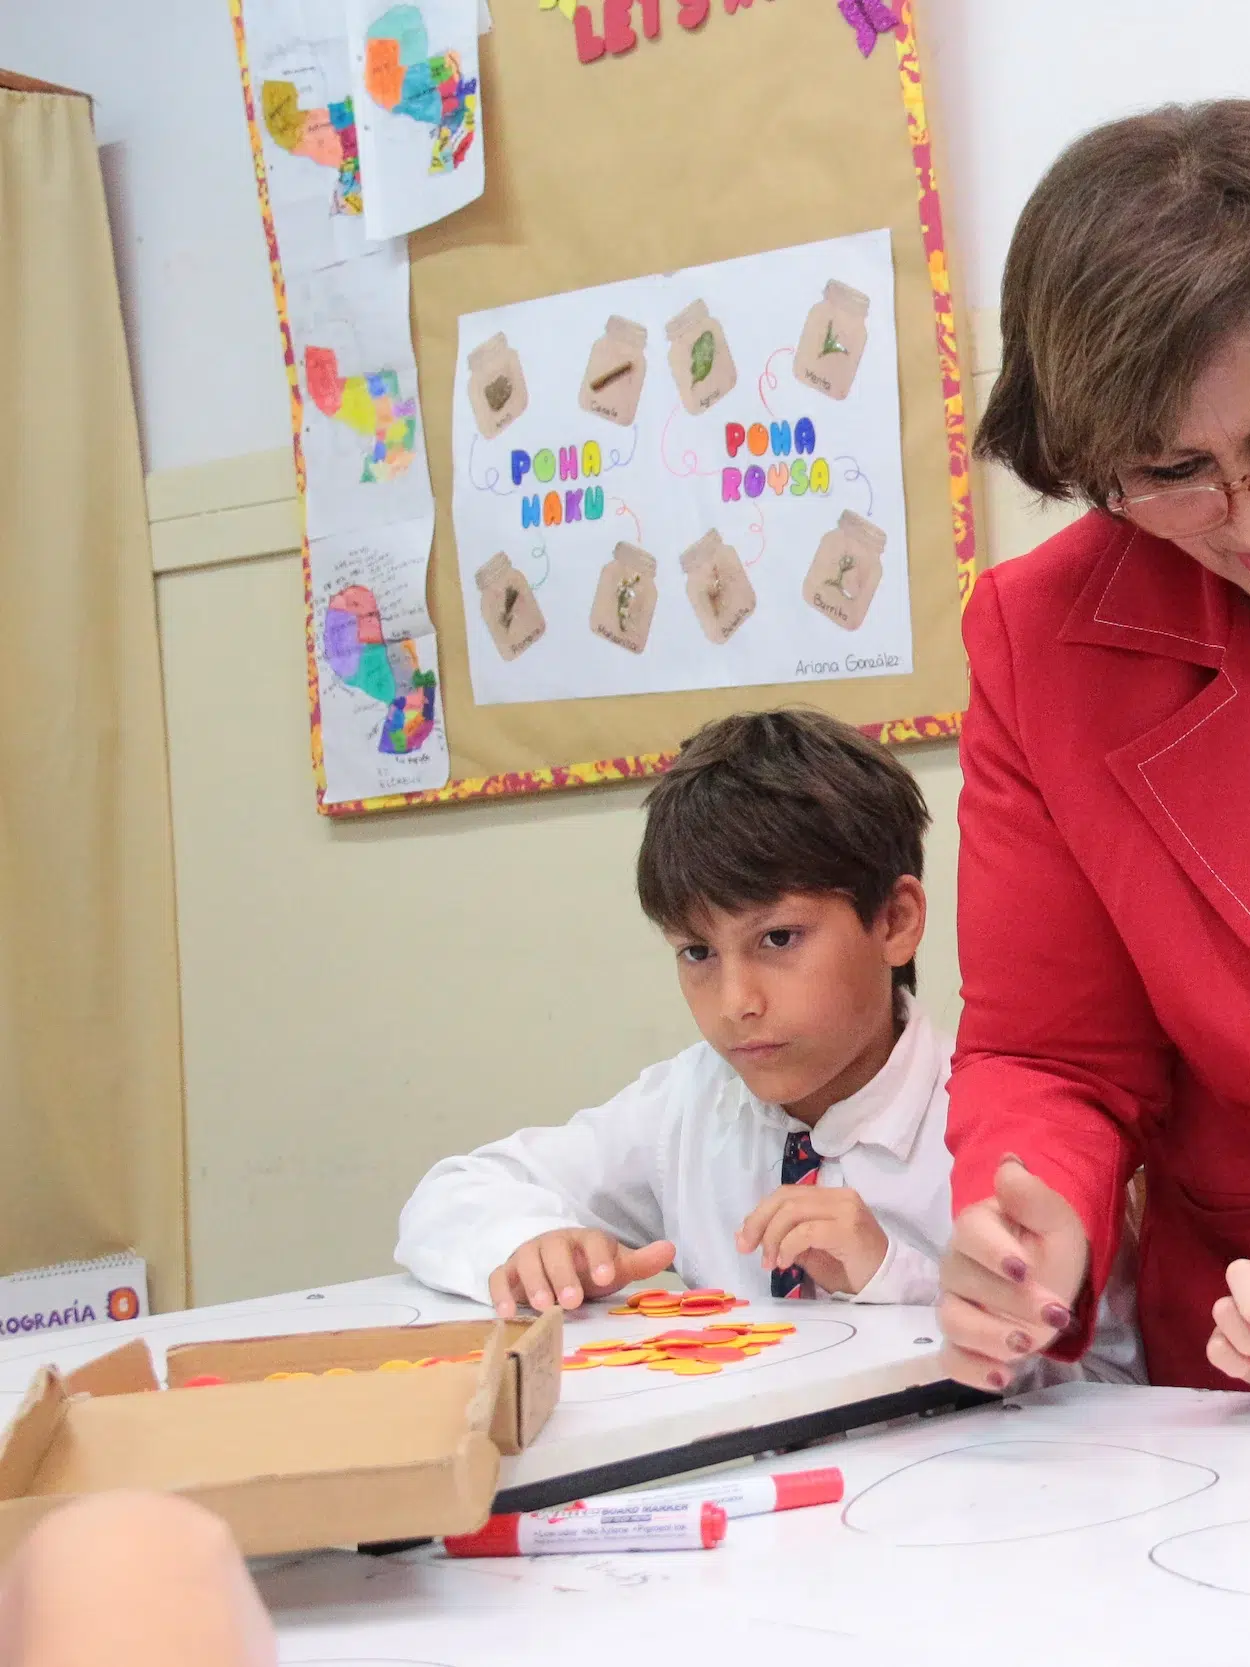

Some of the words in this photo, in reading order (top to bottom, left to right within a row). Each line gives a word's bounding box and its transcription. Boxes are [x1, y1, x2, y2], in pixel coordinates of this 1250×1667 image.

[724, 417, 815, 458] POHA
[511, 440, 601, 485] POHA
[721, 457, 830, 502] ROYSA
[521, 486, 605, 529] HAKU
[795, 661, 839, 676] Ariana
[845, 654, 899, 672] González
